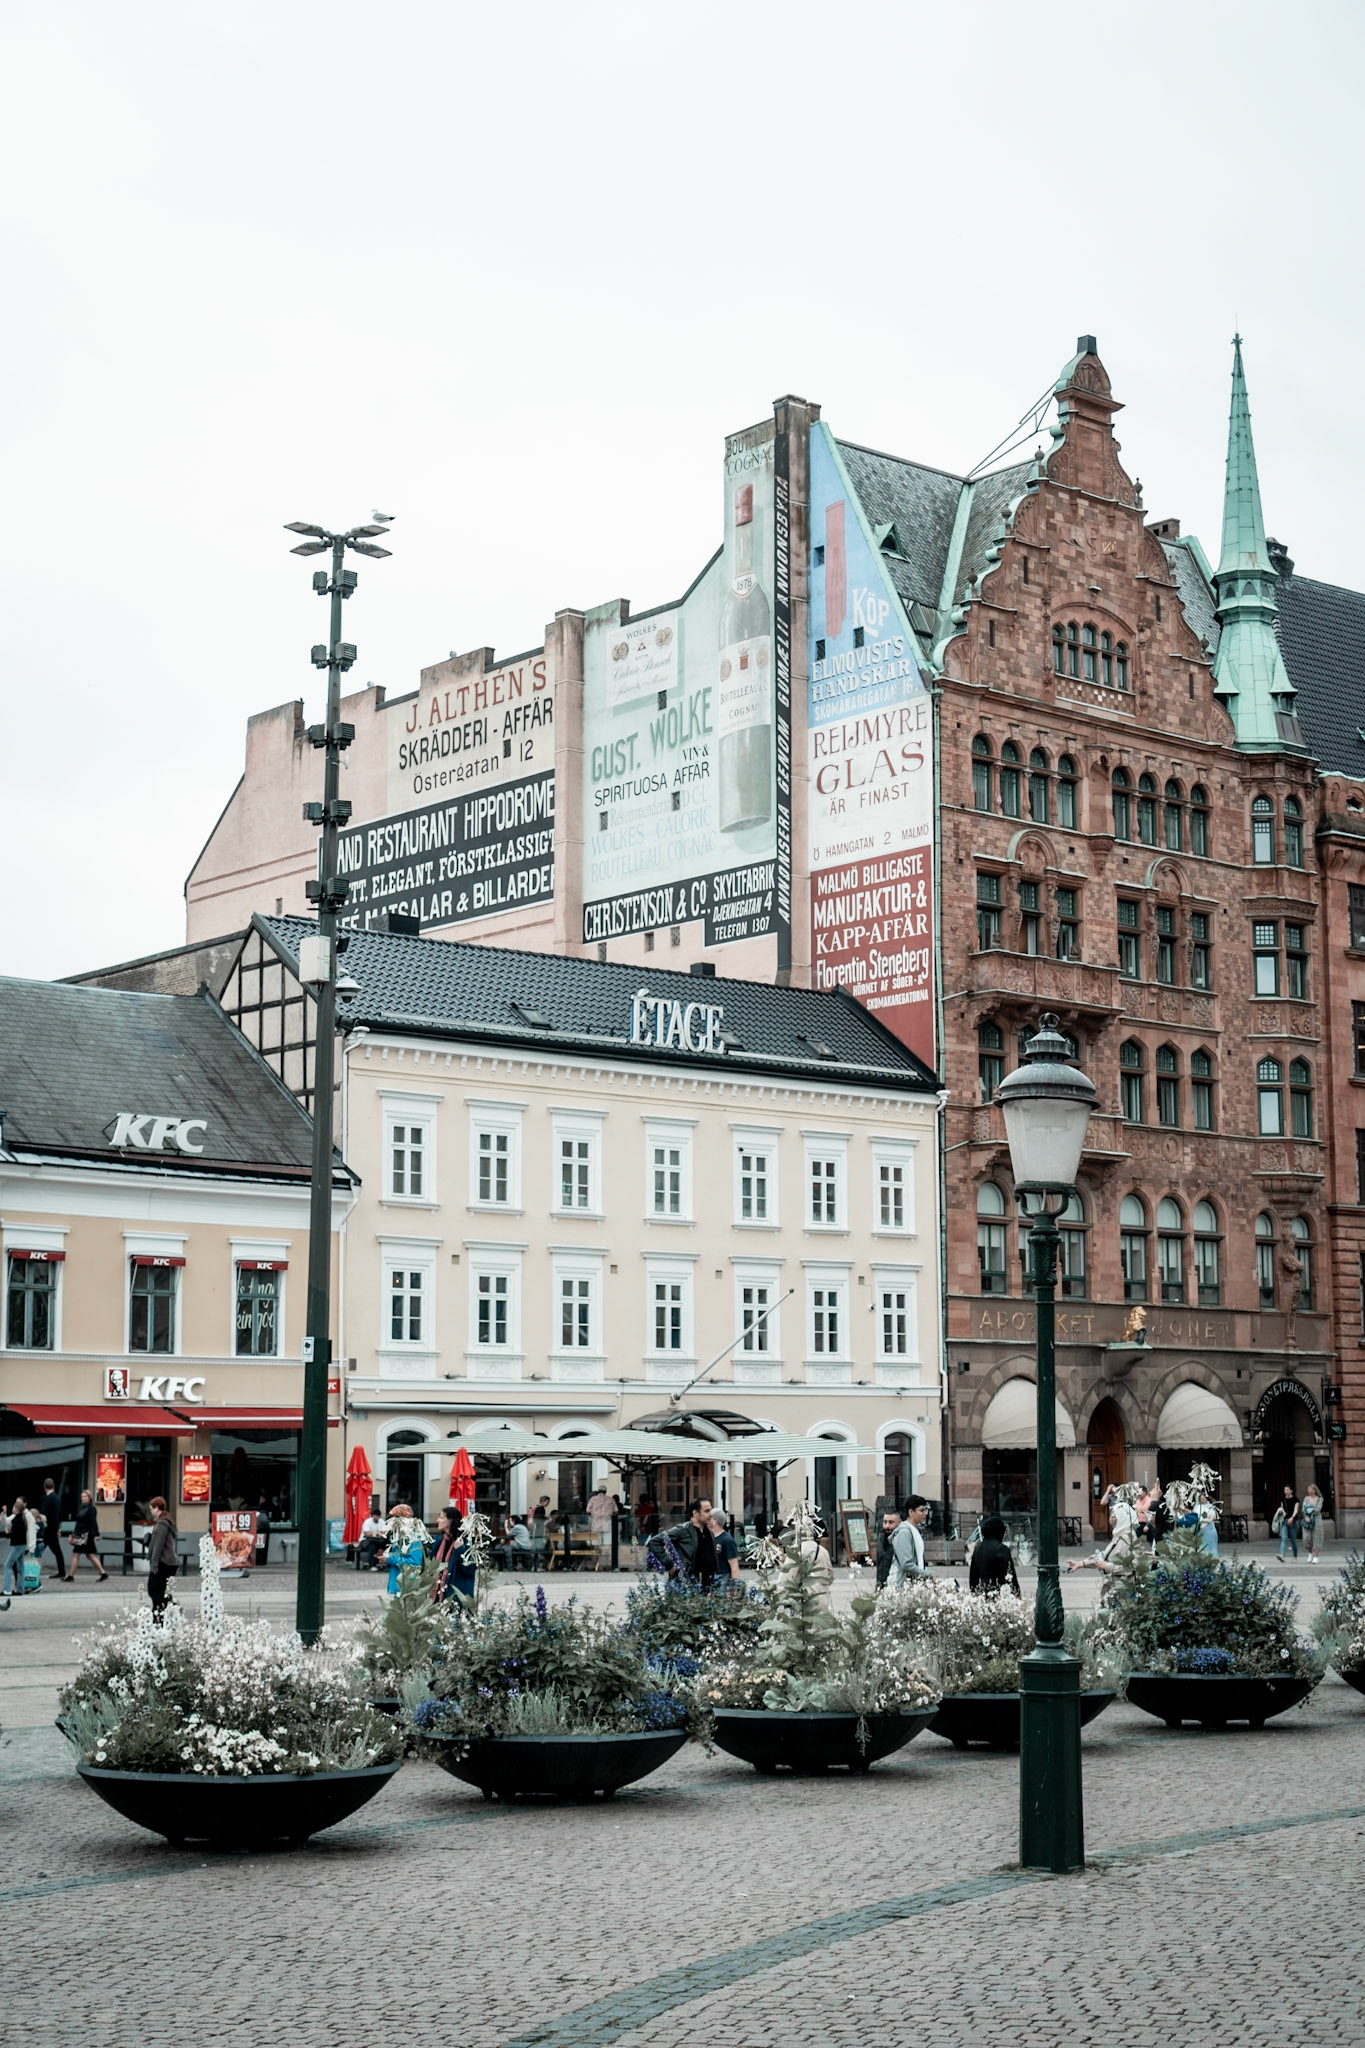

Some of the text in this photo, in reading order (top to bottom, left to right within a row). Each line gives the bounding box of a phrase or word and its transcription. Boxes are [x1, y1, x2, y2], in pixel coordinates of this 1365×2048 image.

[728, 445, 775, 476] COGNAC
[626, 624, 657, 640] WOLKES
[852, 587, 890, 638] KÖP
[811, 635, 904, 683] ELMQVIST'S
[406, 660, 546, 733] J. ALTHÉN'S
[811, 659, 910, 703] HANDSKAR
[814, 683, 897, 721] SKOMAKAREGATAN
[399, 717, 487, 770] SKRÄDDERI
[503, 697, 553, 738] AFFÄR
[592, 687, 713, 782] GUST. WOLKE
[813, 703, 928, 759] REIJMYRE
[414, 739, 534, 794] Östergatan 12
[777, 715, 790, 796] GENOM
[816, 740, 925, 795] GLAS
[594, 761, 710, 807] SPIRITUOSA AFFÄR
[829, 782, 910, 816] ÄR FINAST
[337, 778, 555, 875] AND RESTAURANT HIPPODROME
[592, 805, 713, 856] WOLKES CALORIC
[826, 836, 874, 858] HAMNGATAN
[883, 832, 891, 845] 2
[902, 823, 929, 841] MALMÖ
[591, 831, 717, 883] BOUTELLEAU COGNAC
[778, 803, 790, 924] ANNONSERA
[817, 854, 924, 896] MALMÖ BILLIGASTE
[371, 861, 435, 899] ELEGANT,
[713, 863, 775, 901] SKYLTFABRIK
[456, 892, 469, 913] &
[584, 887, 674, 940] CHRISTENSON
[675, 888, 687, 920] &
[763, 891, 773, 911] 4
[714, 916, 770, 941] TELEFON 1307
[815, 913, 929, 955] KAPP-AFFÄR
[816, 944, 930, 989] Florentin Steneberg
[853, 981, 878, 997] HÖRNET
[880, 979, 889, 992] AF
[866, 988, 929, 1011] SKOMAKAREGATORNA
[629, 988, 725, 1055] ÉTAGE
[109, 1112, 208, 1153] KFC
[29, 1252, 48, 1260] KFC
[153, 1258, 170, 1266] KFC
[256, 1262, 273, 1270] KFC
[979, 1310, 1095, 1334] APOTKET
[137, 1376, 206, 1402] KFC
[328, 1382, 337, 1391] FC
[1256, 1381, 1322, 1423] JONETPASSAGEN
[216, 1521, 238, 1532] FOR 2
[238, 1514, 251, 1528] 99
